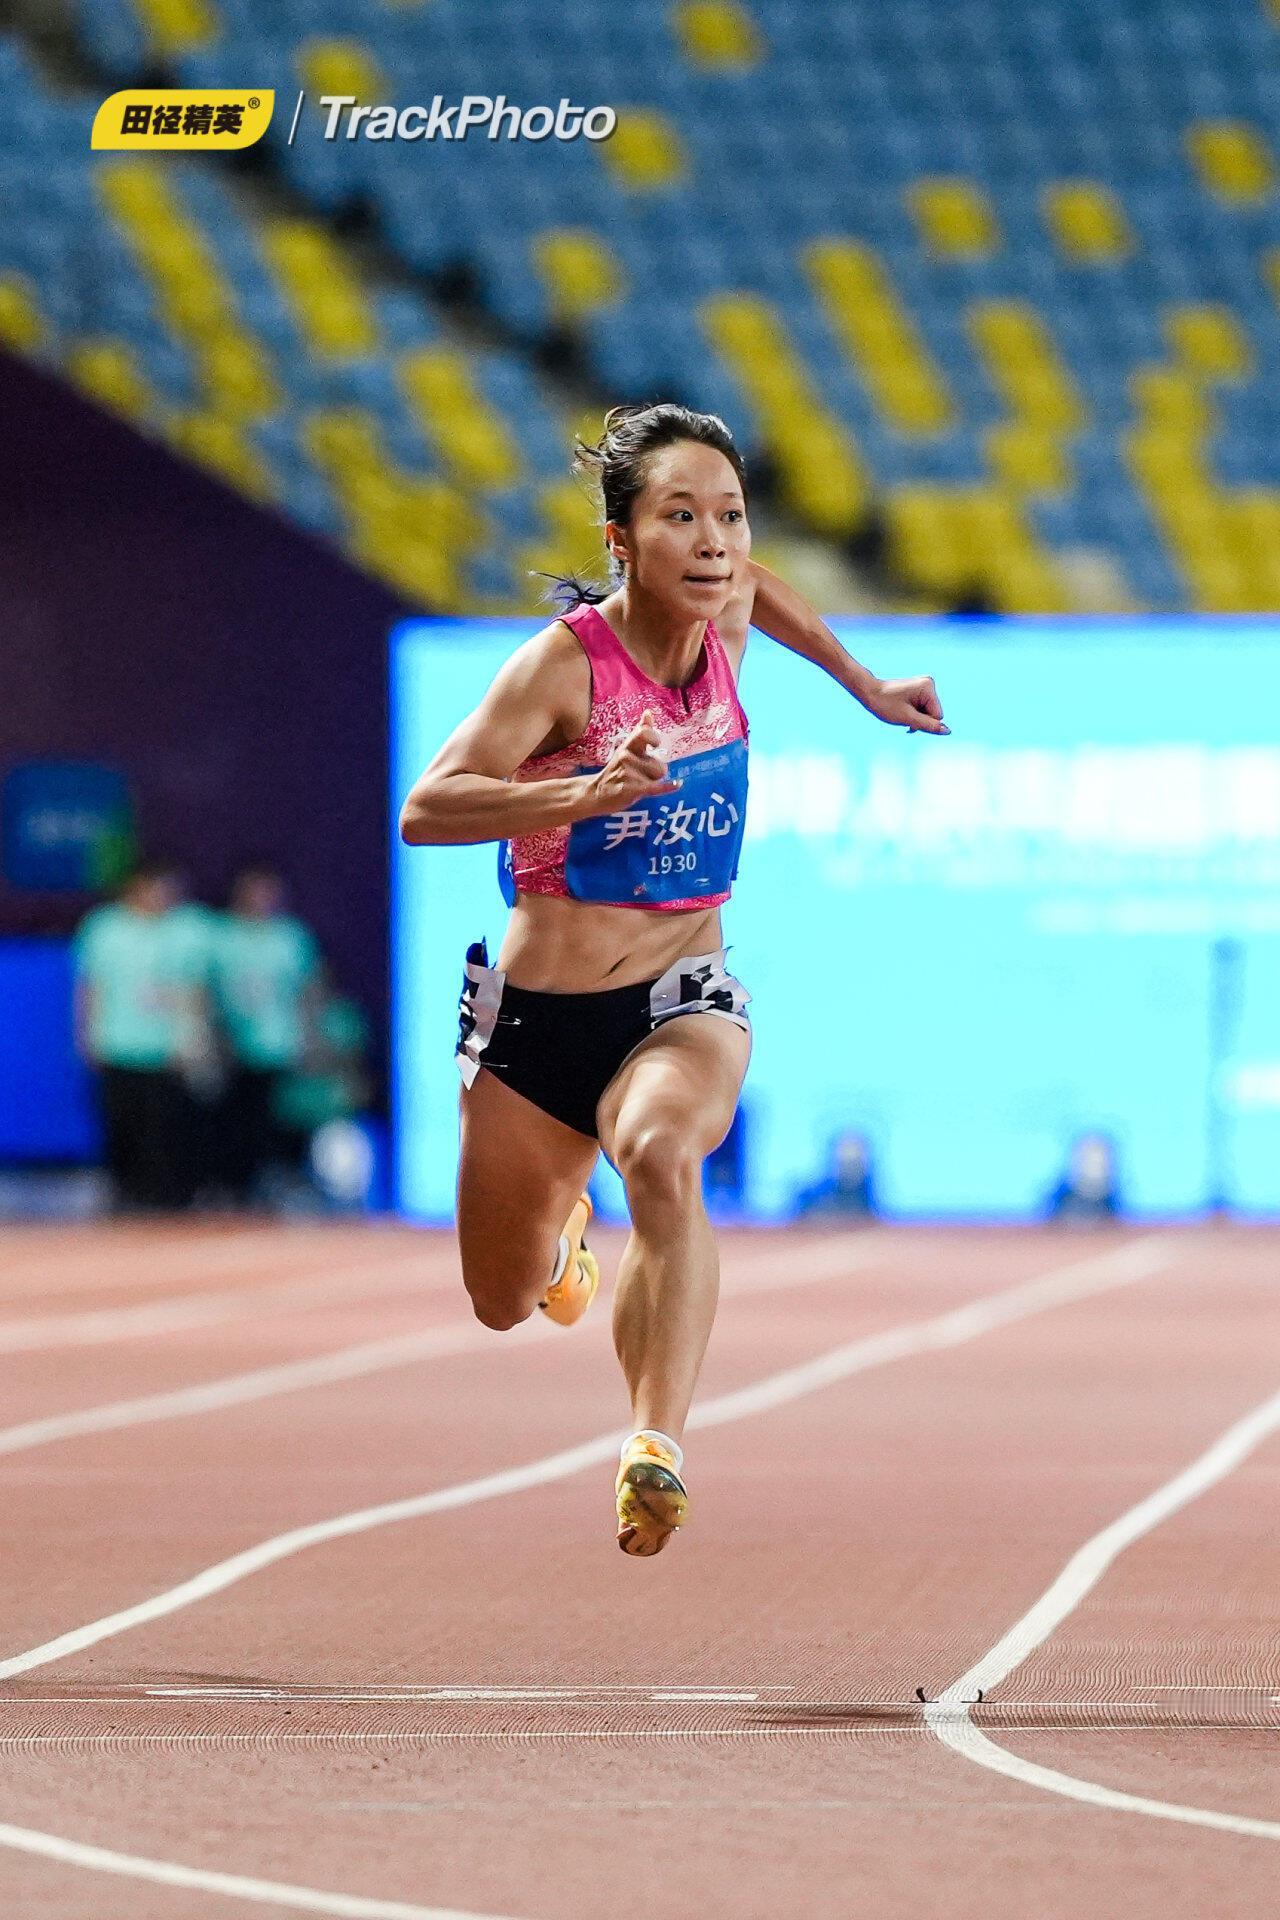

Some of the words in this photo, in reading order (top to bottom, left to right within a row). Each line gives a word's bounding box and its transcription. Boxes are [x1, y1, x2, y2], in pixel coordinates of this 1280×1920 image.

[603, 792, 739, 850] 尹汝心
[647, 852, 697, 875] 1930
